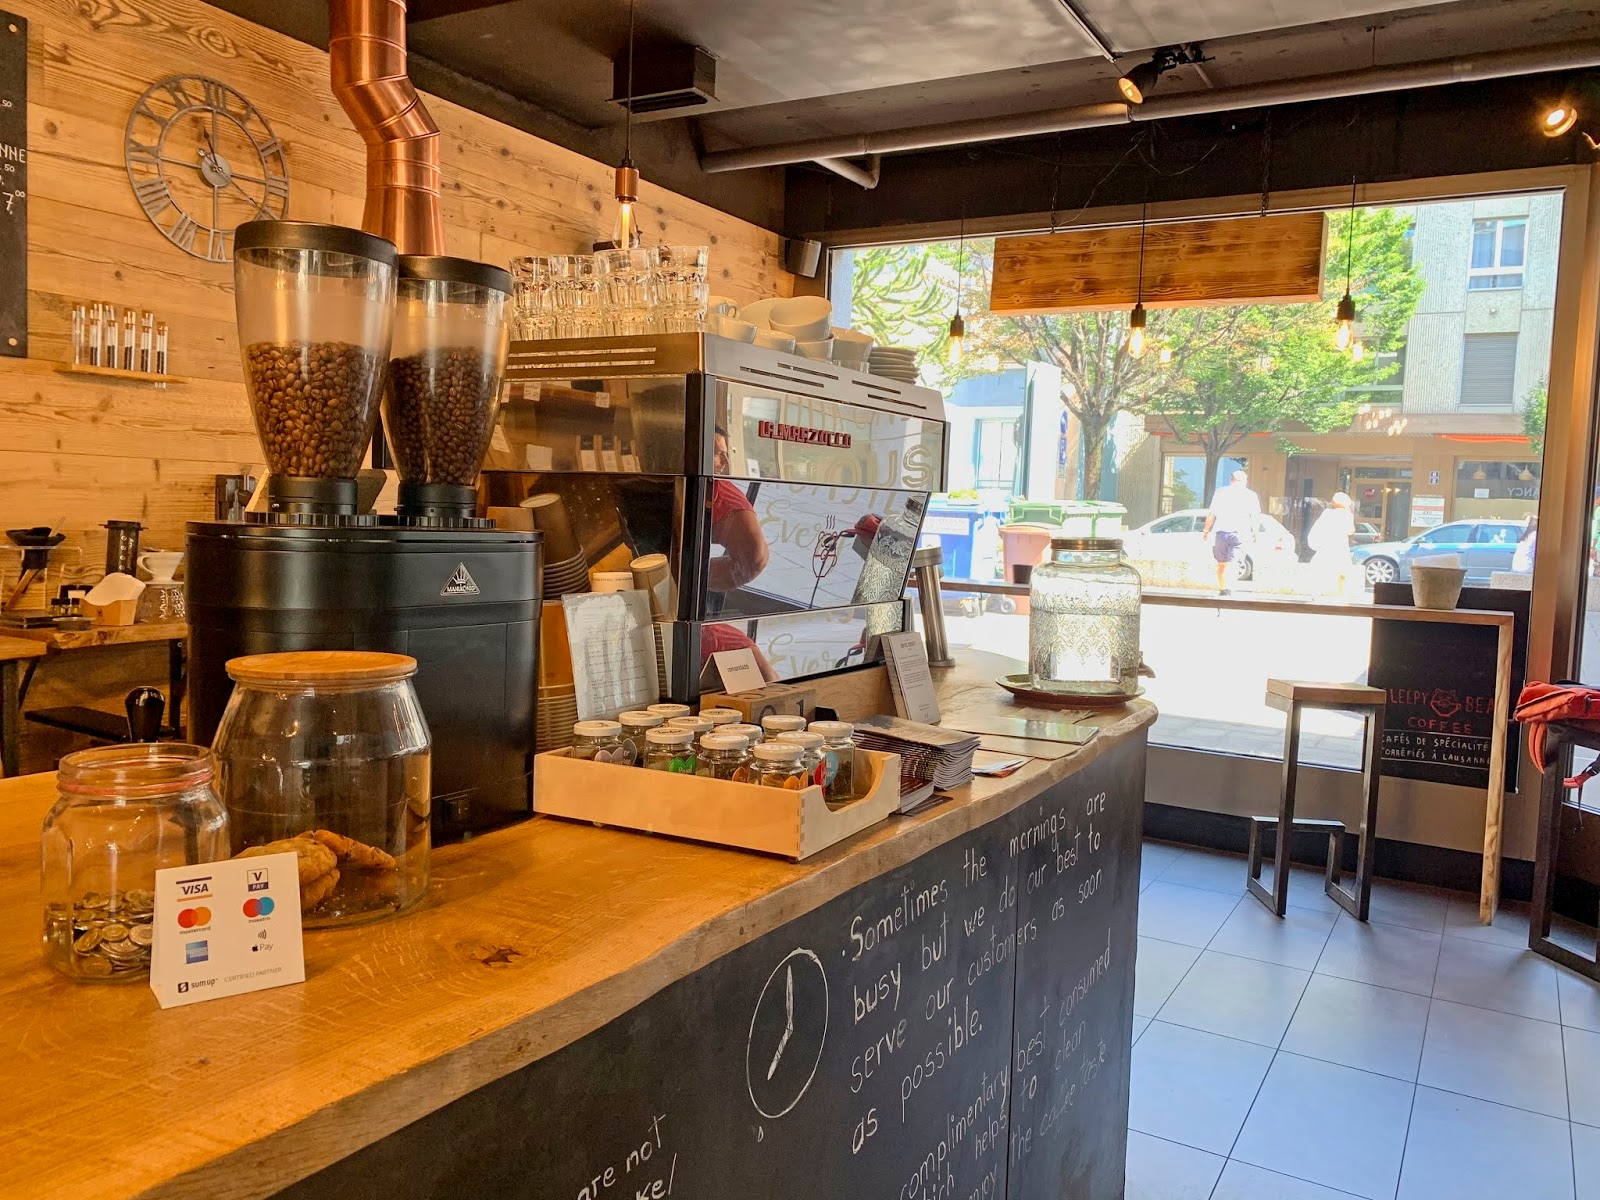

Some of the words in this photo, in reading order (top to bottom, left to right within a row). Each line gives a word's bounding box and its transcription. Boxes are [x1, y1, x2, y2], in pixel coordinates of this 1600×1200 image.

[1388, 688, 1427, 705] LEEPY
[1466, 696, 1494, 713] BEA
[1408, 717, 1472, 734] COFFEE
[1382, 732, 1410, 746] AFÉS
[1416, 737, 1426, 746] DE
[1382, 747, 1426, 759] ORRÉFIÉS
[181, 883, 209, 896] VISA
[850, 879, 948, 962] Sometimes
[963, 847, 987, 888] the
[1009, 806, 1066, 858] mornings
[1086, 792, 1106, 816] are
[260, 943, 274, 952] Pay
[854, 962, 901, 1025] busy
[922, 911, 949, 972] but
[963, 906, 985, 938] we
[999, 875, 1016, 913] do
[1027, 864, 1047, 895] our
[1056, 826, 1082, 876] best
[1088, 822, 1101, 854] to
[850, 1019, 907, 1093] serve
[925, 977, 954, 1020] our
[967, 918, 1037, 986] customers
[1051, 898, 1065, 921] as
[1078, 869, 1103, 904] soon
[1017, 995, 1050, 1072] best
[1059, 927, 1111, 1026] consumed
[852, 1108, 878, 1155] as
[901, 994, 983, 1123] possible.
[975, 1108, 1007, 1161] helps
[1020, 1075, 1037, 1112] to
[1054, 1021, 1086, 1070] clean
[626, 1113, 667, 1174] not
[1010, 1124, 1032, 1168] the
